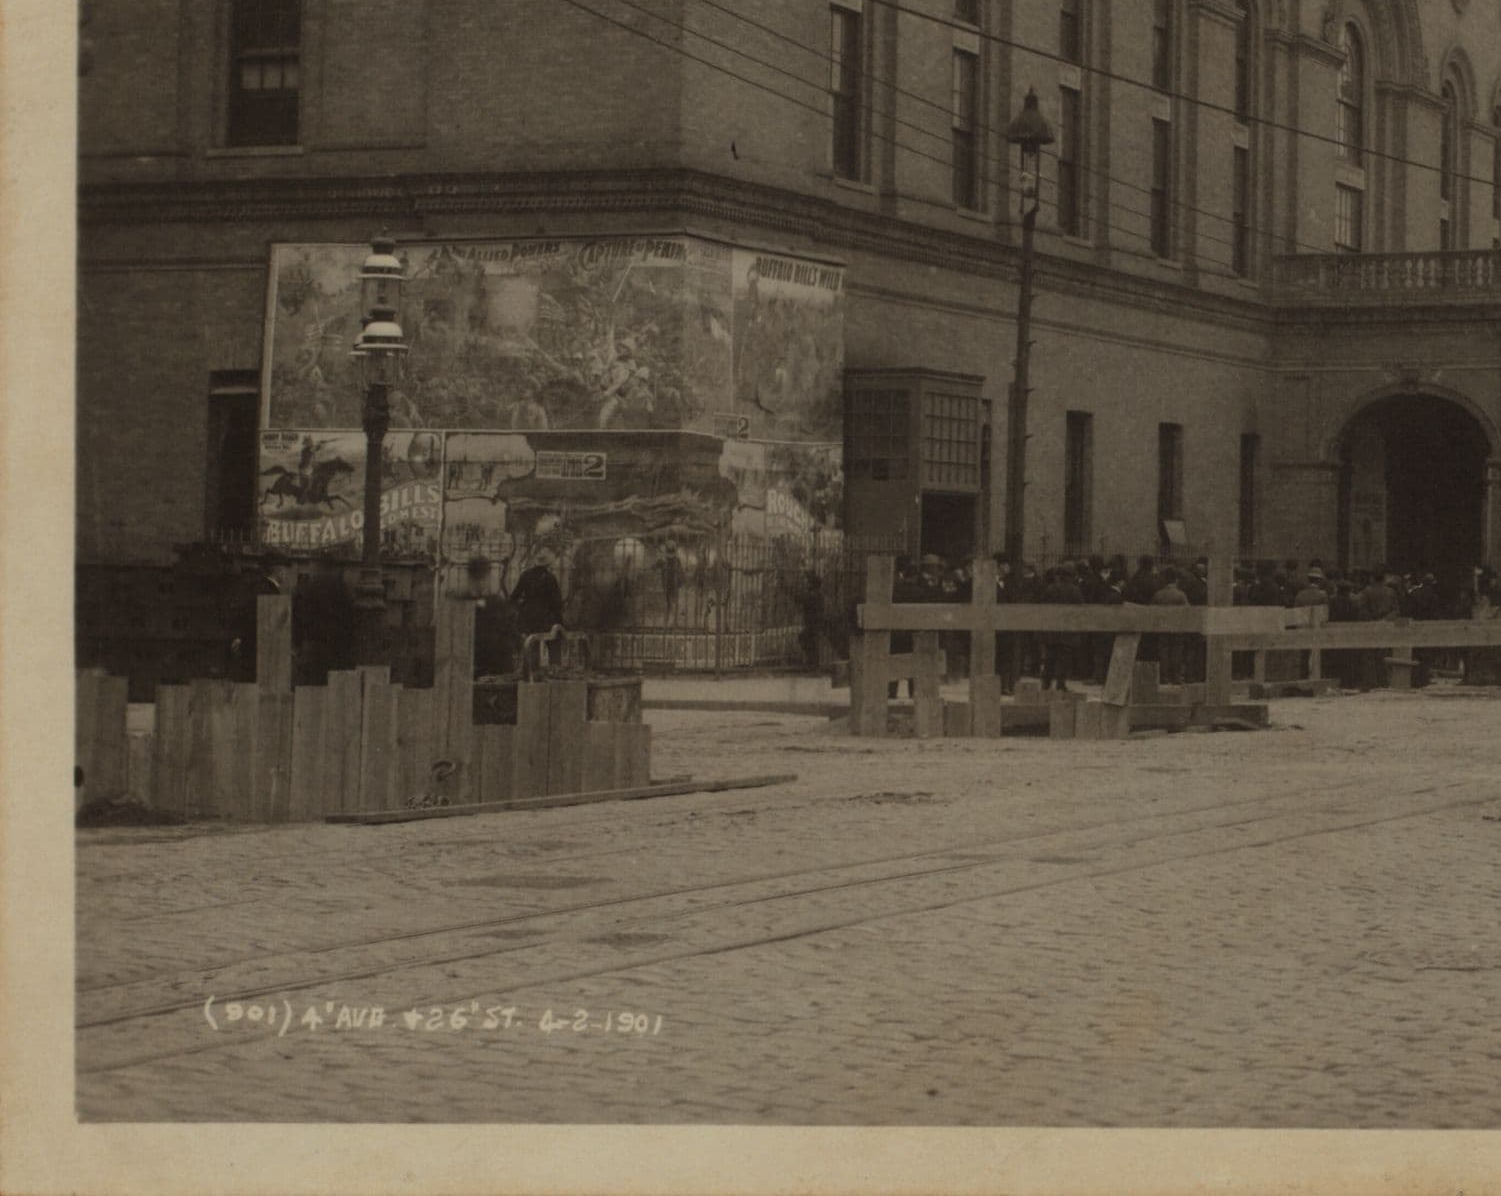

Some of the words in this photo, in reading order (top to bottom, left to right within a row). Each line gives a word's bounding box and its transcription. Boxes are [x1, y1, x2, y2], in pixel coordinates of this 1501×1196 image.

[511, 241, 561, 262] POWERS
[738, 416, 749, 439] 2
[584, 454, 604, 478] 2
[266, 510, 364, 545] BUFFALO
